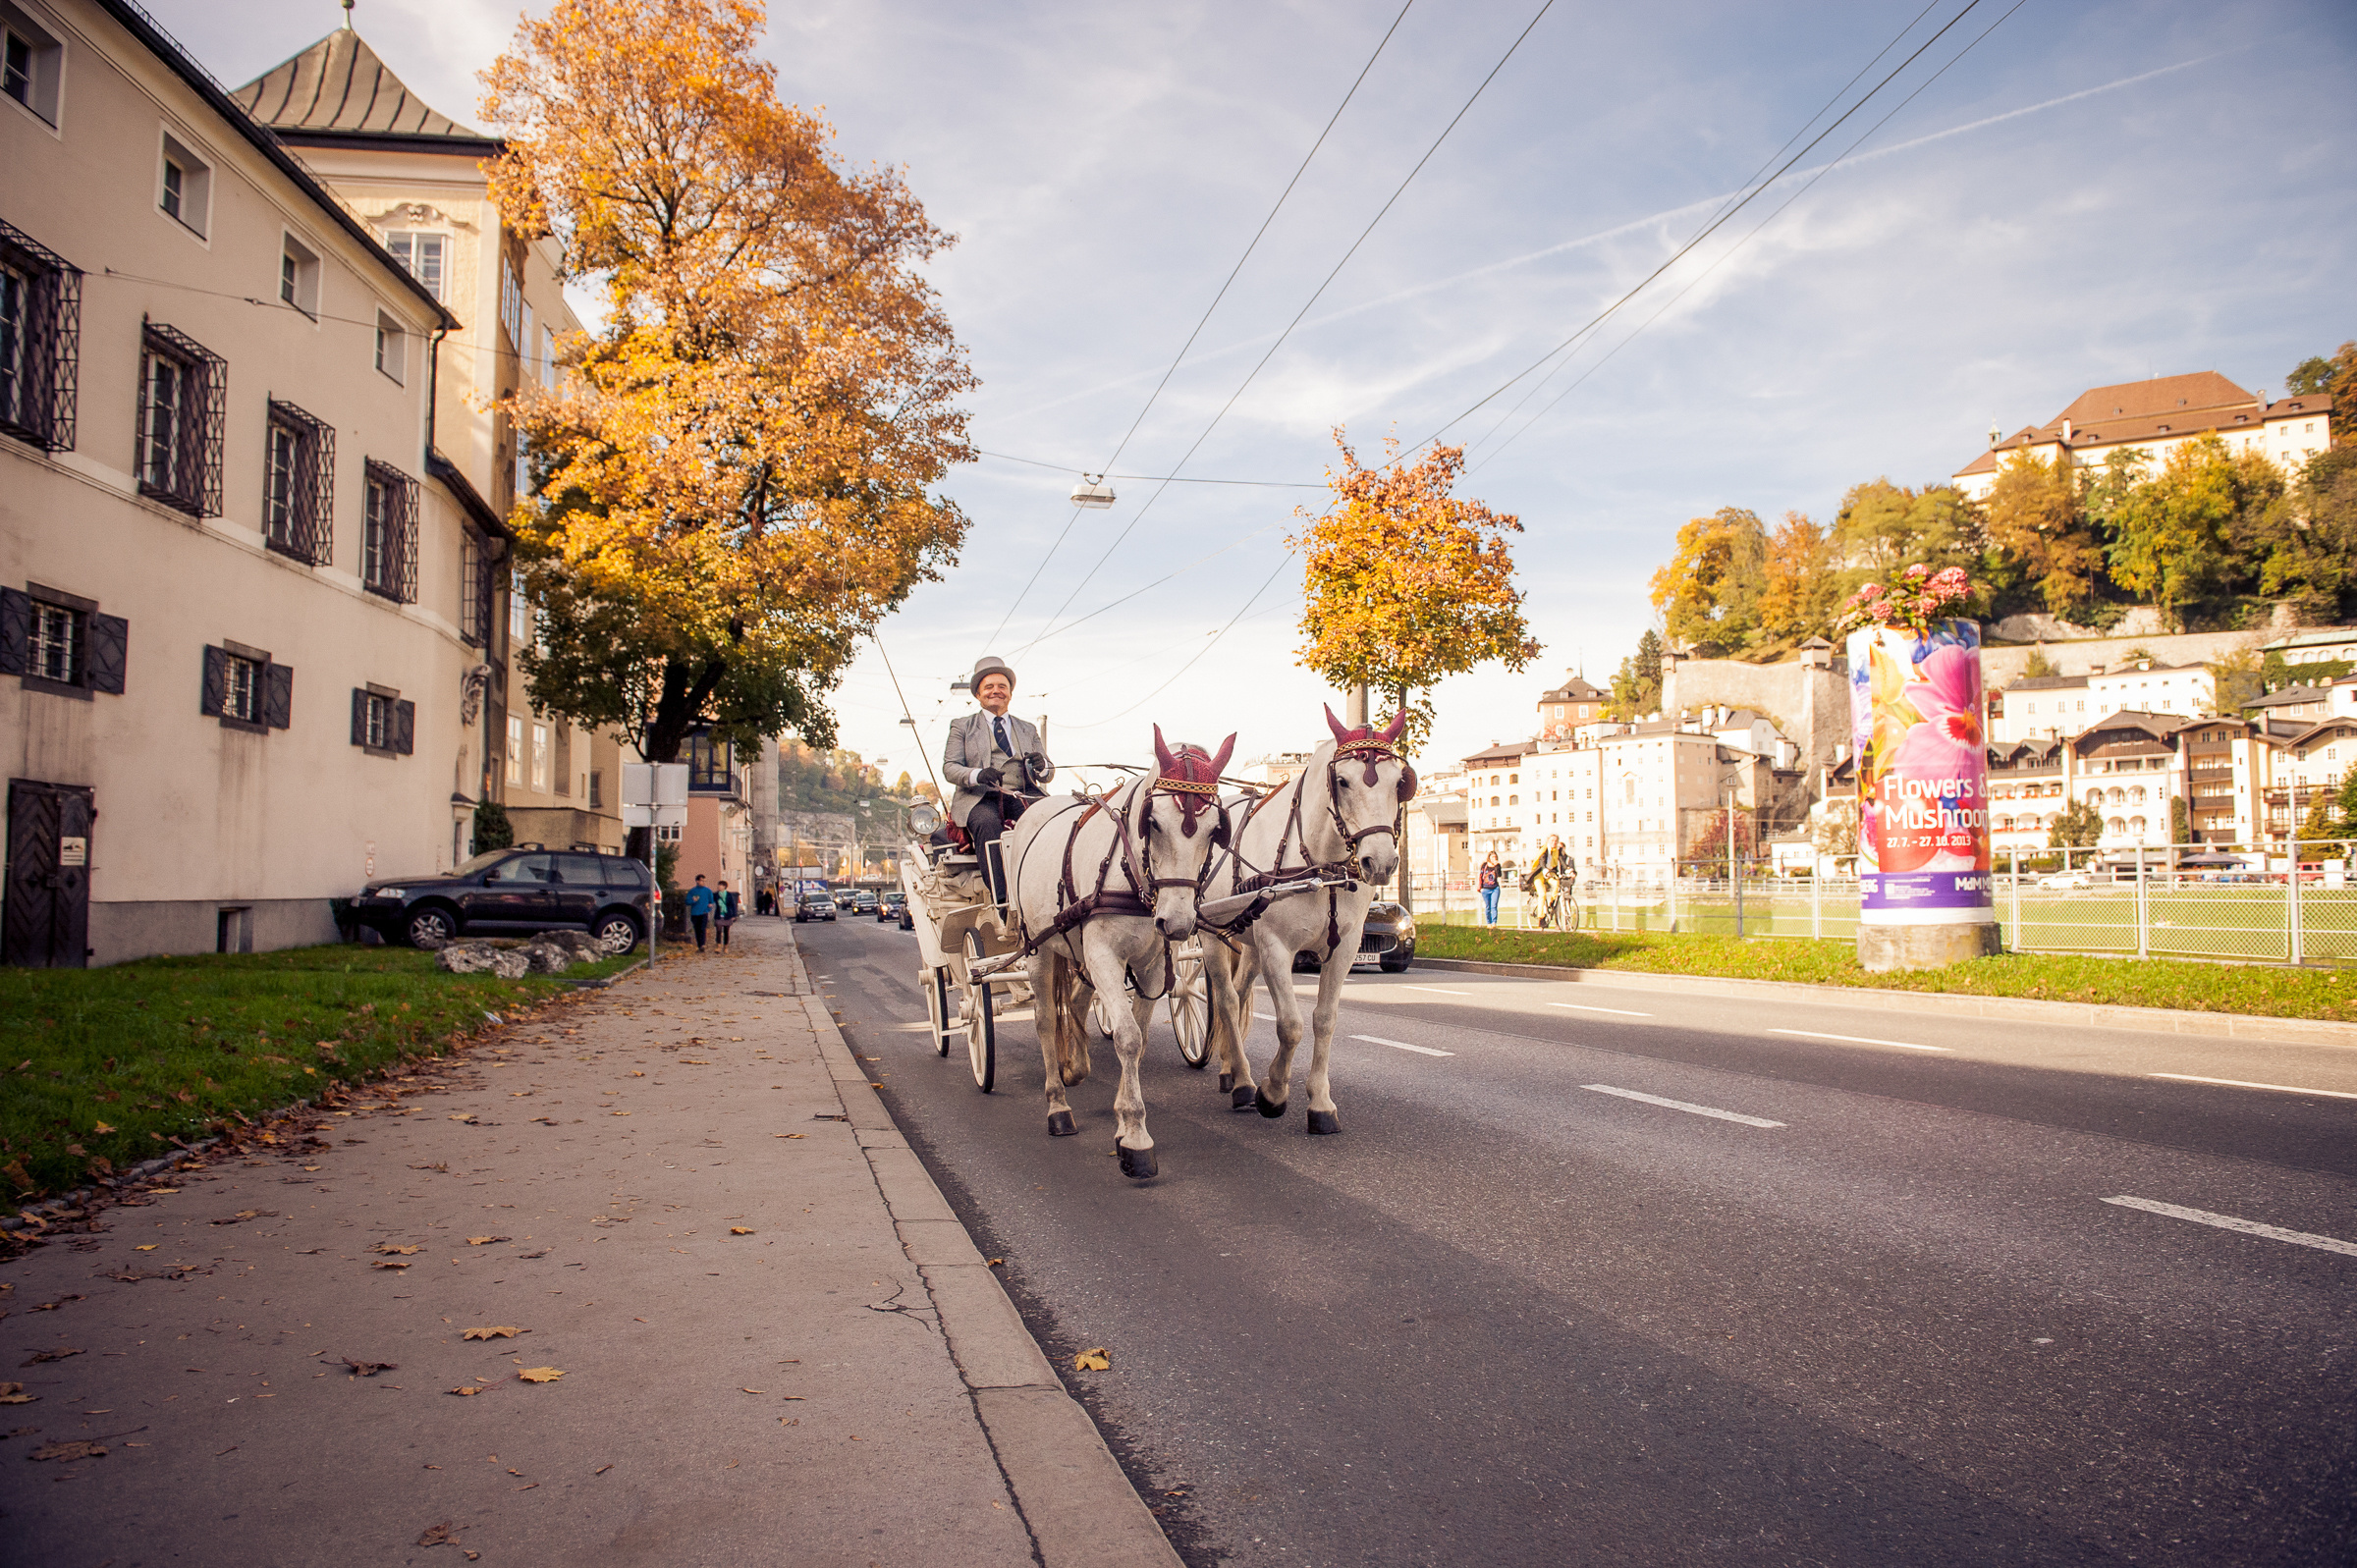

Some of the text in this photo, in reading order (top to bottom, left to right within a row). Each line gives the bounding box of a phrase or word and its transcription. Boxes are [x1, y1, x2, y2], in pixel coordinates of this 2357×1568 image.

[1884, 773, 1987, 800] Flowers &
[1950, 835, 1971, 846] 2013
